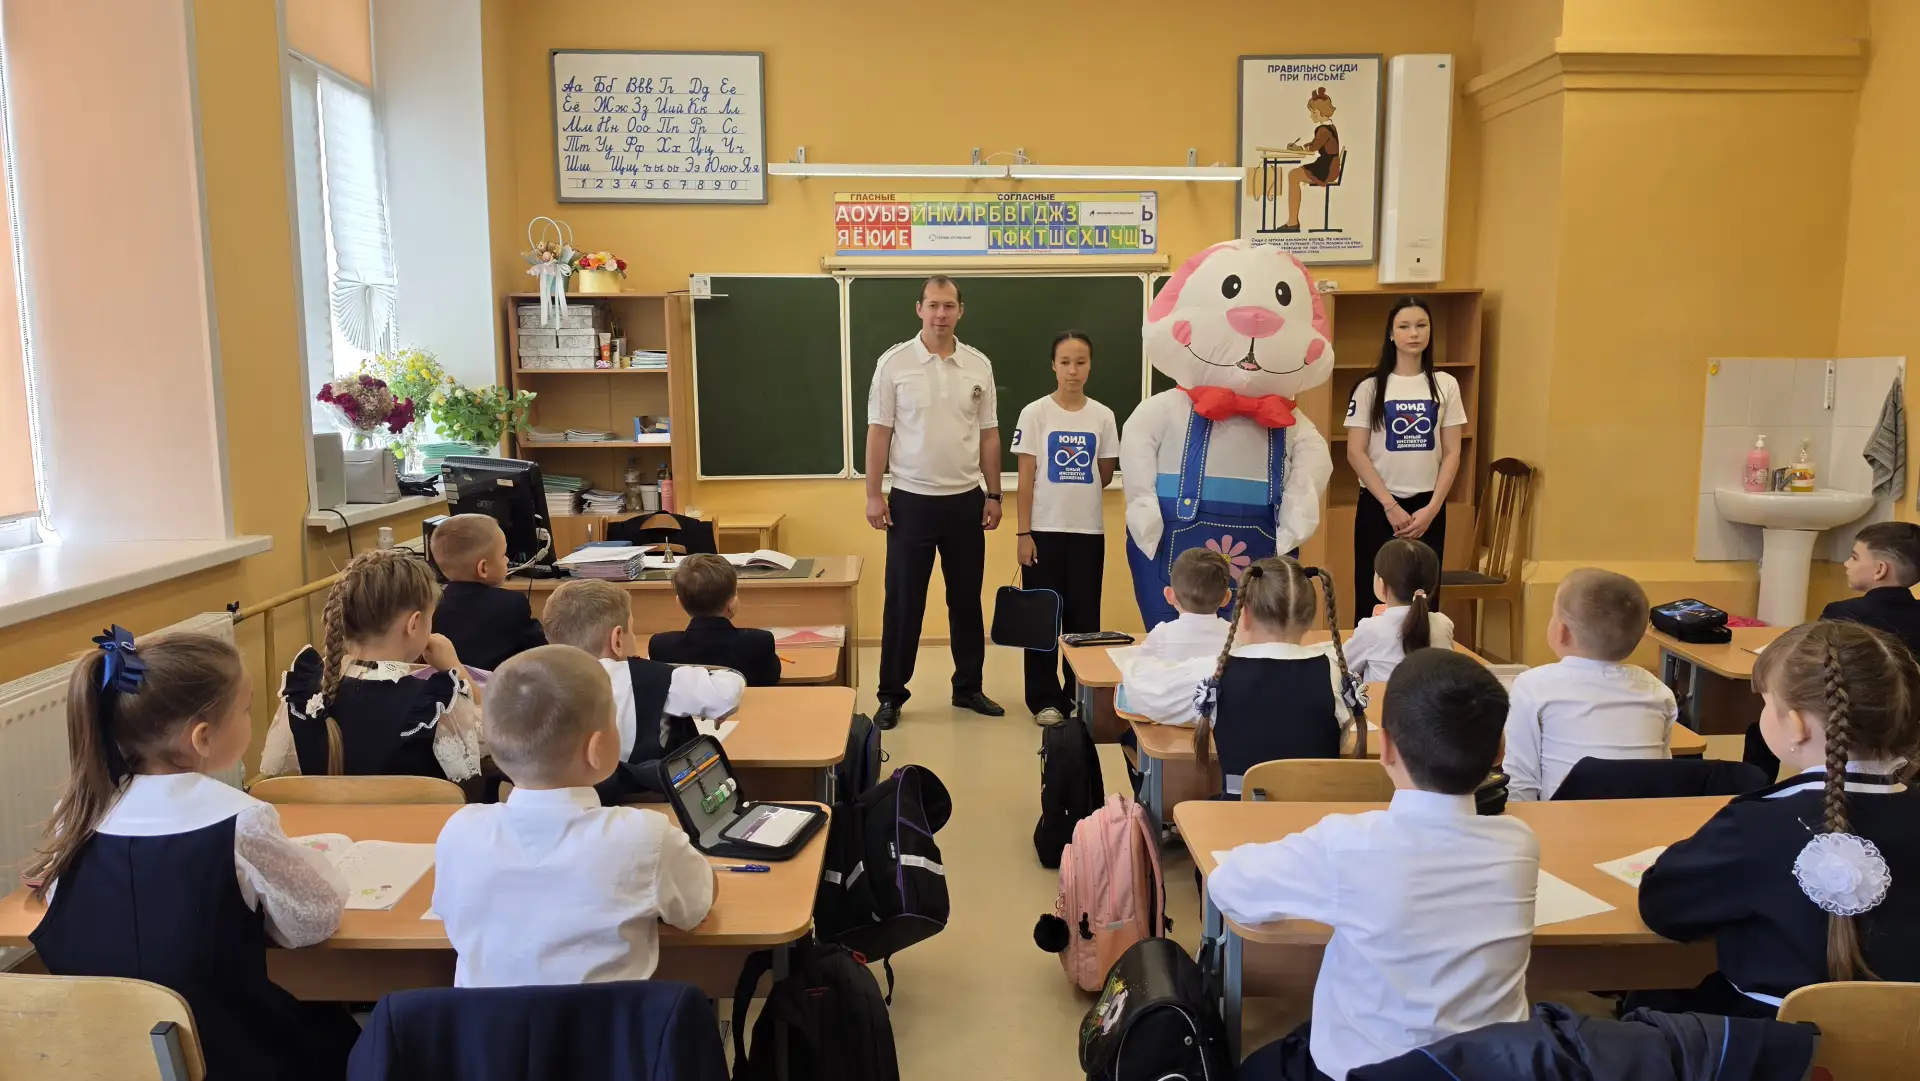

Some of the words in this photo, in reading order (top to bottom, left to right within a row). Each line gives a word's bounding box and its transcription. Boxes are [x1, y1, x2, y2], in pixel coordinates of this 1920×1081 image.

[1267, 64, 1326, 73] ПРАВИЛЬНО
[1329, 64, 1358, 73] СИДИ
[1280, 73, 1299, 81] ПРИ
[1303, 72, 1345, 81] ПИСЬМЕ
[561, 76, 583, 93] Аа
[593, 76, 618, 93] Бб
[722, 118, 738, 134] Сс
[580, 179, 586, 190] 1
[595, 179, 603, 190] 2
[612, 179, 620, 190] 3
[629, 179, 637, 190] 4
[645, 179, 654, 190] 5
[662, 179, 670, 190] 6
[679, 179, 687, 190] 7
[697, 179, 704, 190] 8
[713, 179, 721, 190] 9
[729, 179, 737, 190] 0
[850, 193, 896, 201] ГЛАСНЫЕ
[997, 193, 1055, 201] СОГЛАСНЫЕ
[1395, 402, 1426, 412] ЮИД
[1058, 435, 1087, 446] ЮИД
